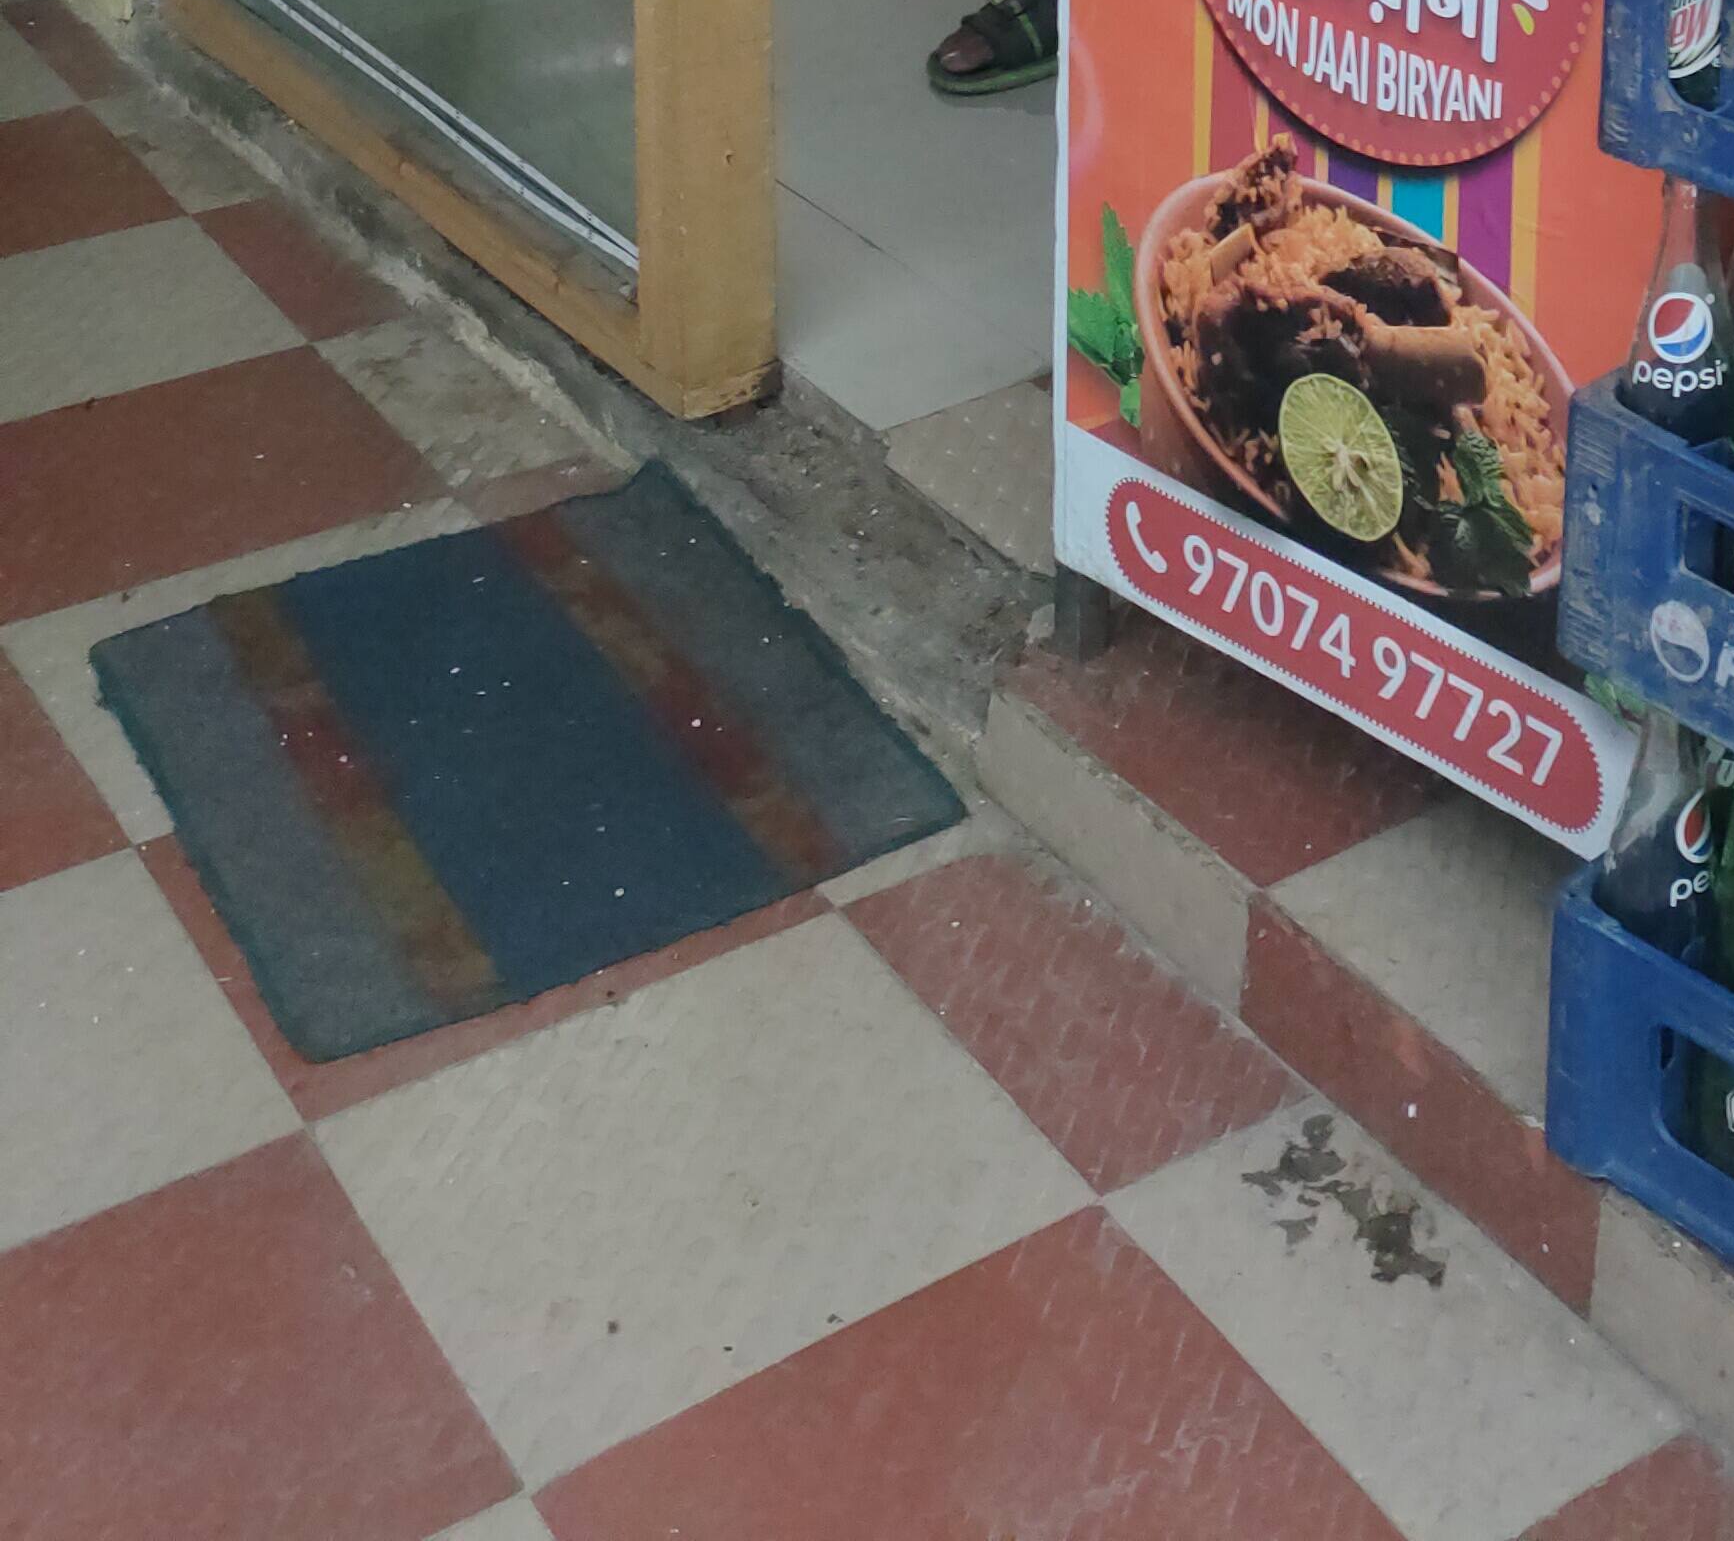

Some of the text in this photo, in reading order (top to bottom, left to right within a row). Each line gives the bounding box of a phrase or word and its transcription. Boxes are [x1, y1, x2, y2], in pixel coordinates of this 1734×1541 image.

[1303, 16, 1368, 104] JAAI
[1376, 42, 1503, 122] BIRYANI
[1632, 359, 1724, 397] pepsi
[1183, 534, 1564, 787] 97074 97727
